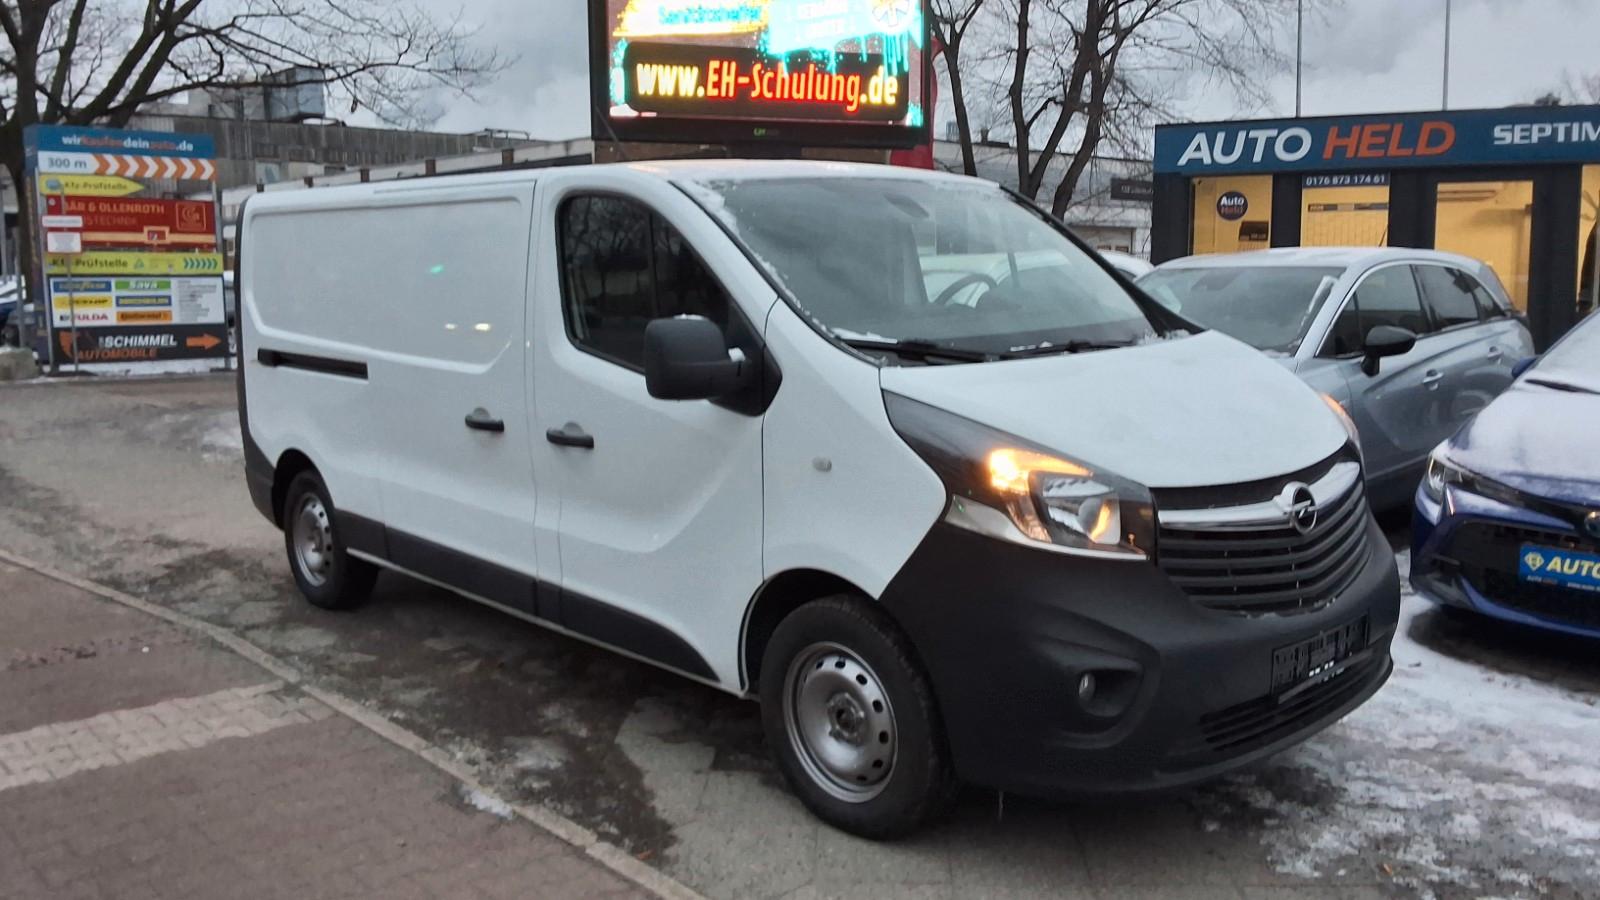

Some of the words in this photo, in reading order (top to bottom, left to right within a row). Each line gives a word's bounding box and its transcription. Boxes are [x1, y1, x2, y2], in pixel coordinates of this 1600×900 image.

[636, 60, 898, 112] www.EH-Schulung.de
[62, 135, 194, 152] wirkaufendeinauto.de
[1177, 128, 1312, 166] AUTO
[1322, 121, 1456, 160] HELD
[48, 157, 71, 168] 300
[75, 159, 87, 169] m
[1306, 176, 1330, 186] 0176
[1353, 174, 1371, 184] 174
[1373, 174, 1385, 184] 61
[1220, 195, 1245, 206] Auto
[104, 333, 177, 348] SCHIMMEL
